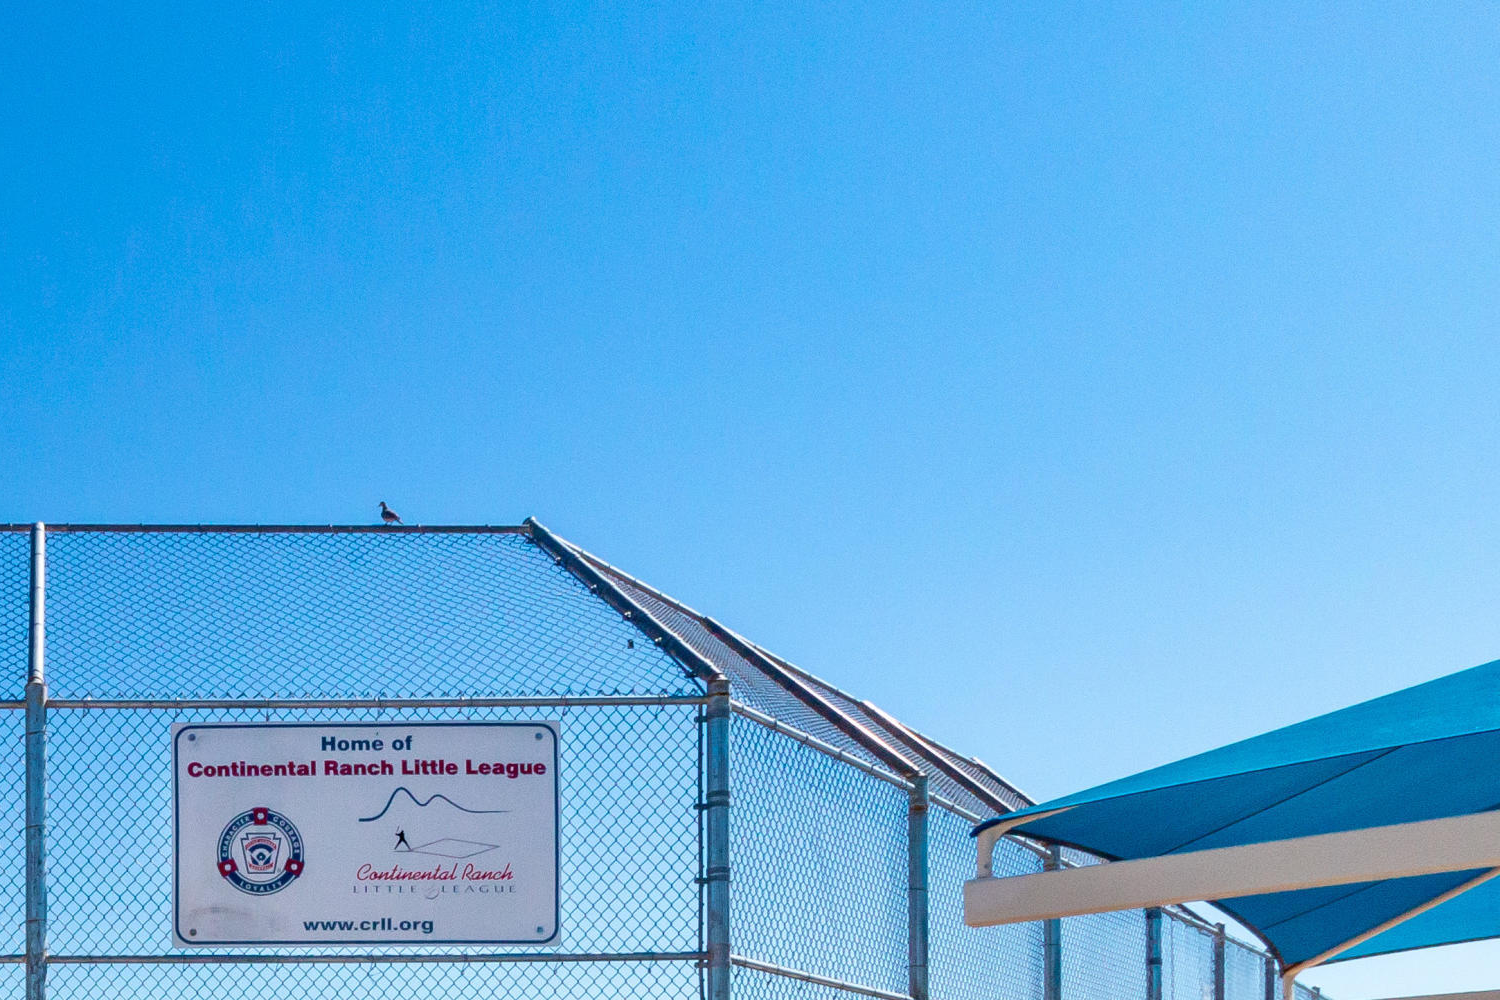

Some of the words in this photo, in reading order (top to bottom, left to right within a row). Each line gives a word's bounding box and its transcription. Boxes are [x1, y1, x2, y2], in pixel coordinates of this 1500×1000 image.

[321, 736, 384, 751] Home
[392, 735, 413, 751] of
[187, 761, 316, 777] Continental
[324, 760, 394, 776] Ranch
[401, 759, 458, 775] Little
[465, 759, 546, 779] League
[221, 815, 251, 857] CHARACTER
[272, 816, 300, 854] COURAGE
[356, 862, 459, 881] Continental
[461, 862, 514, 881] Ranch
[239, 880, 283, 893] LOYALTY
[353, 884, 417, 894] LITTLE
[440, 884, 517, 894] LEAGUE
[303, 918, 434, 934] www.crll.org
